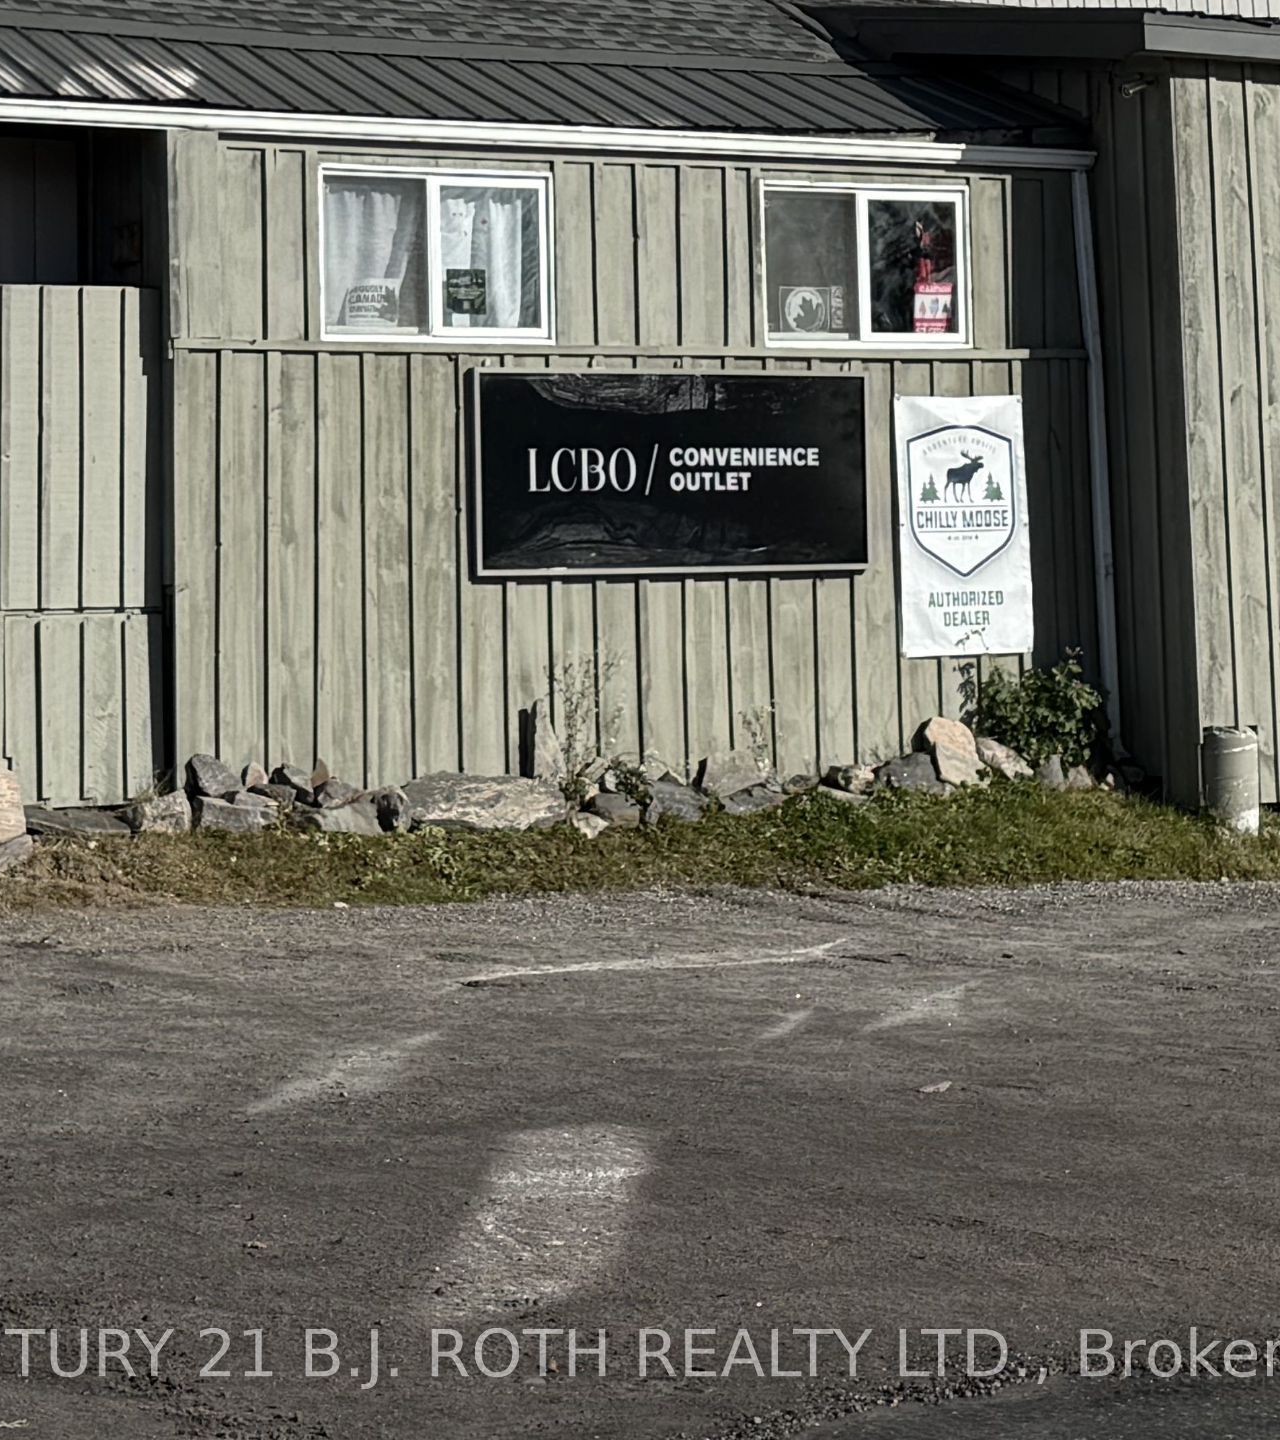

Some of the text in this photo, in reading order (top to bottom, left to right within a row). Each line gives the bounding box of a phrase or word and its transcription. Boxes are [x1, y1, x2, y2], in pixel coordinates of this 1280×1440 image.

[527, 445, 820, 493] LCBO CONVENIENCE
[669, 471, 752, 492] OUTLET
[916, 509, 1009, 529] CHILLY MOOSE
[927, 589, 1004, 608] AUTHORIZED
[942, 610, 991, 627] DEALER
